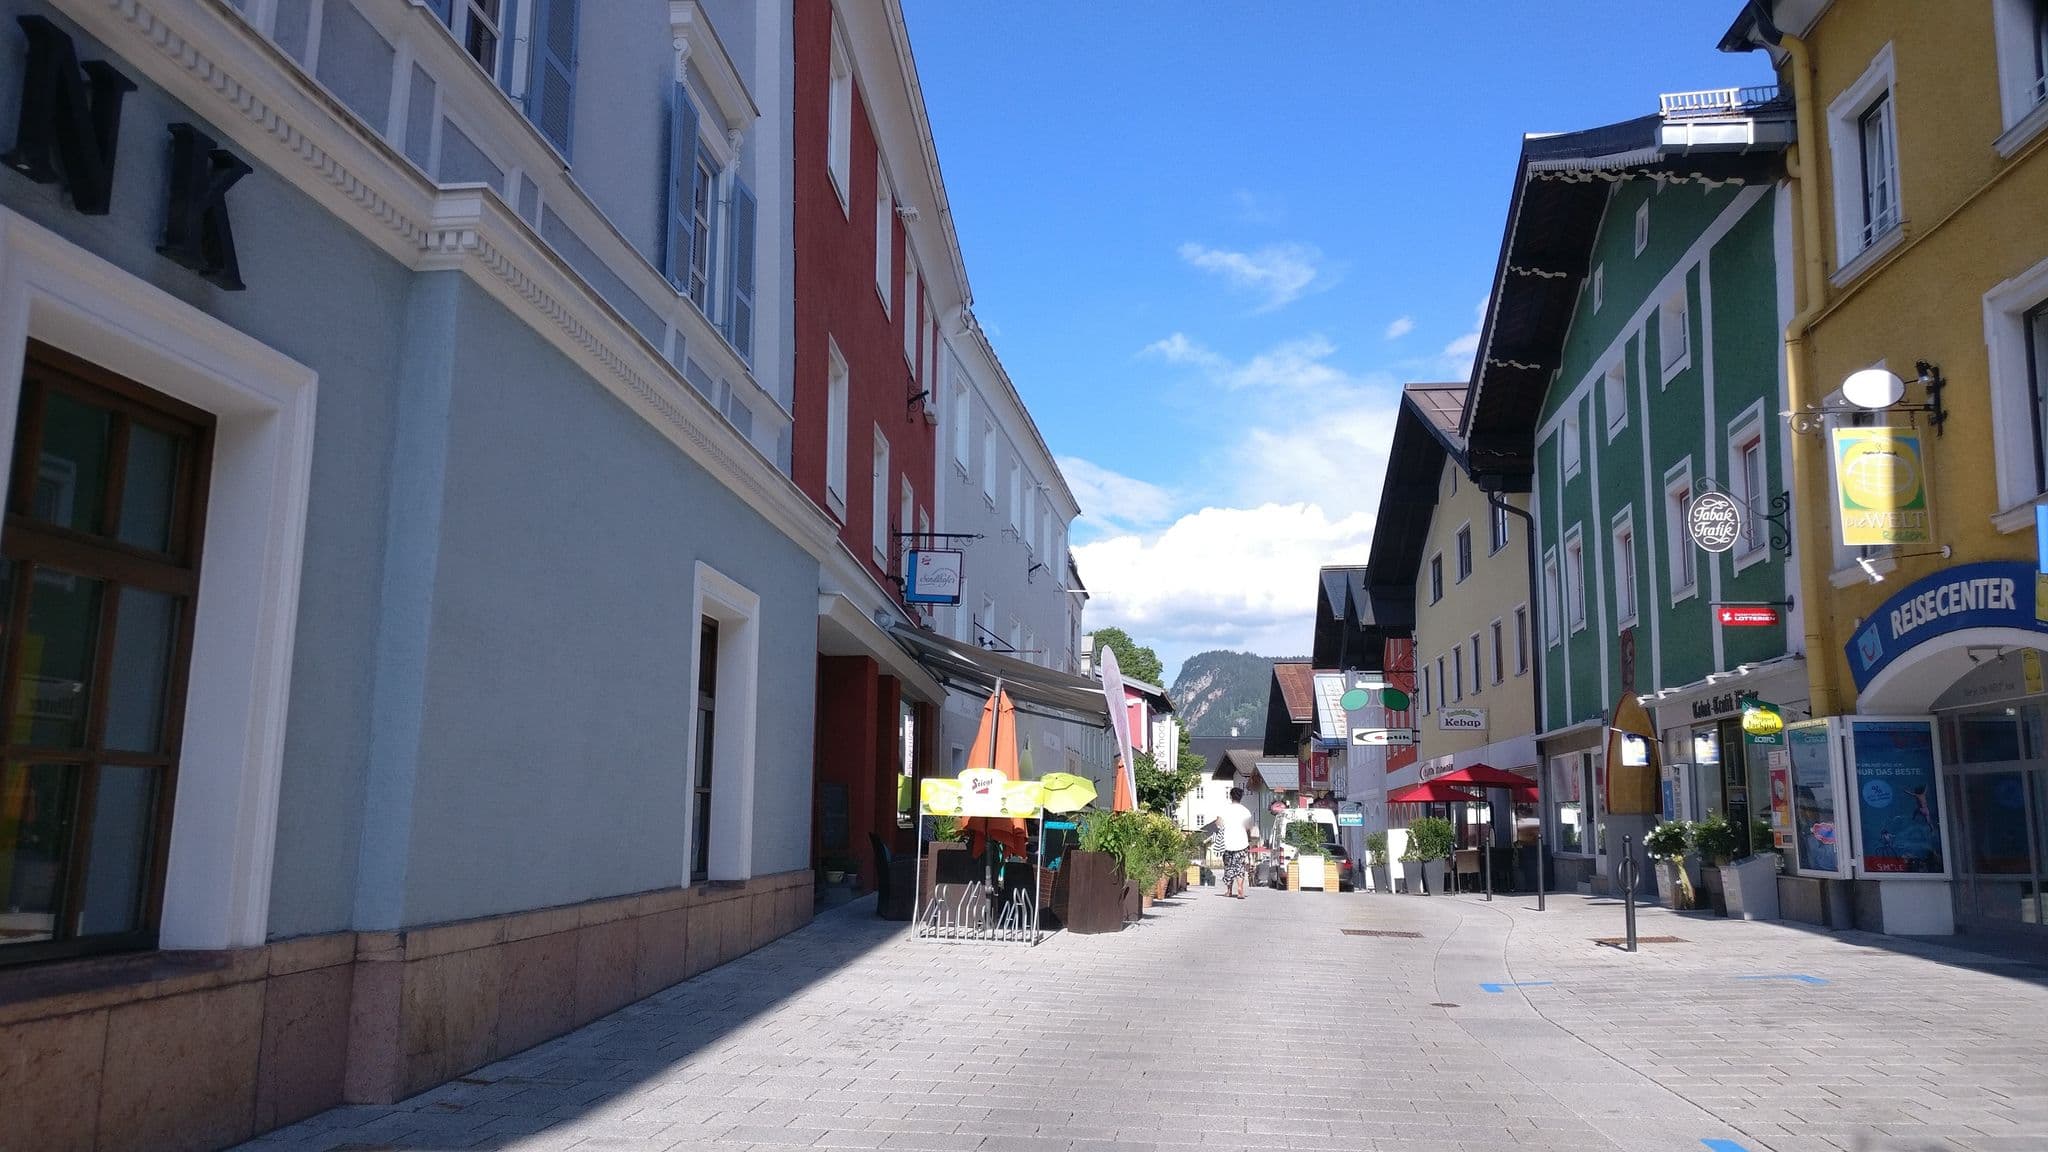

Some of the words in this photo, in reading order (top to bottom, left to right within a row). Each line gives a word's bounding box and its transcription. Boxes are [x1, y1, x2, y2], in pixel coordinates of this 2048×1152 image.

[1693, 506, 1736, 523] Tabak
[1694, 521, 1736, 537] Trafik
[1891, 577, 2017, 640] REISECENTER
[1445, 717, 1481, 728] Kebap
[1754, 735, 1776, 744] LOTTO
[1876, 768, 1892, 776] DAS
